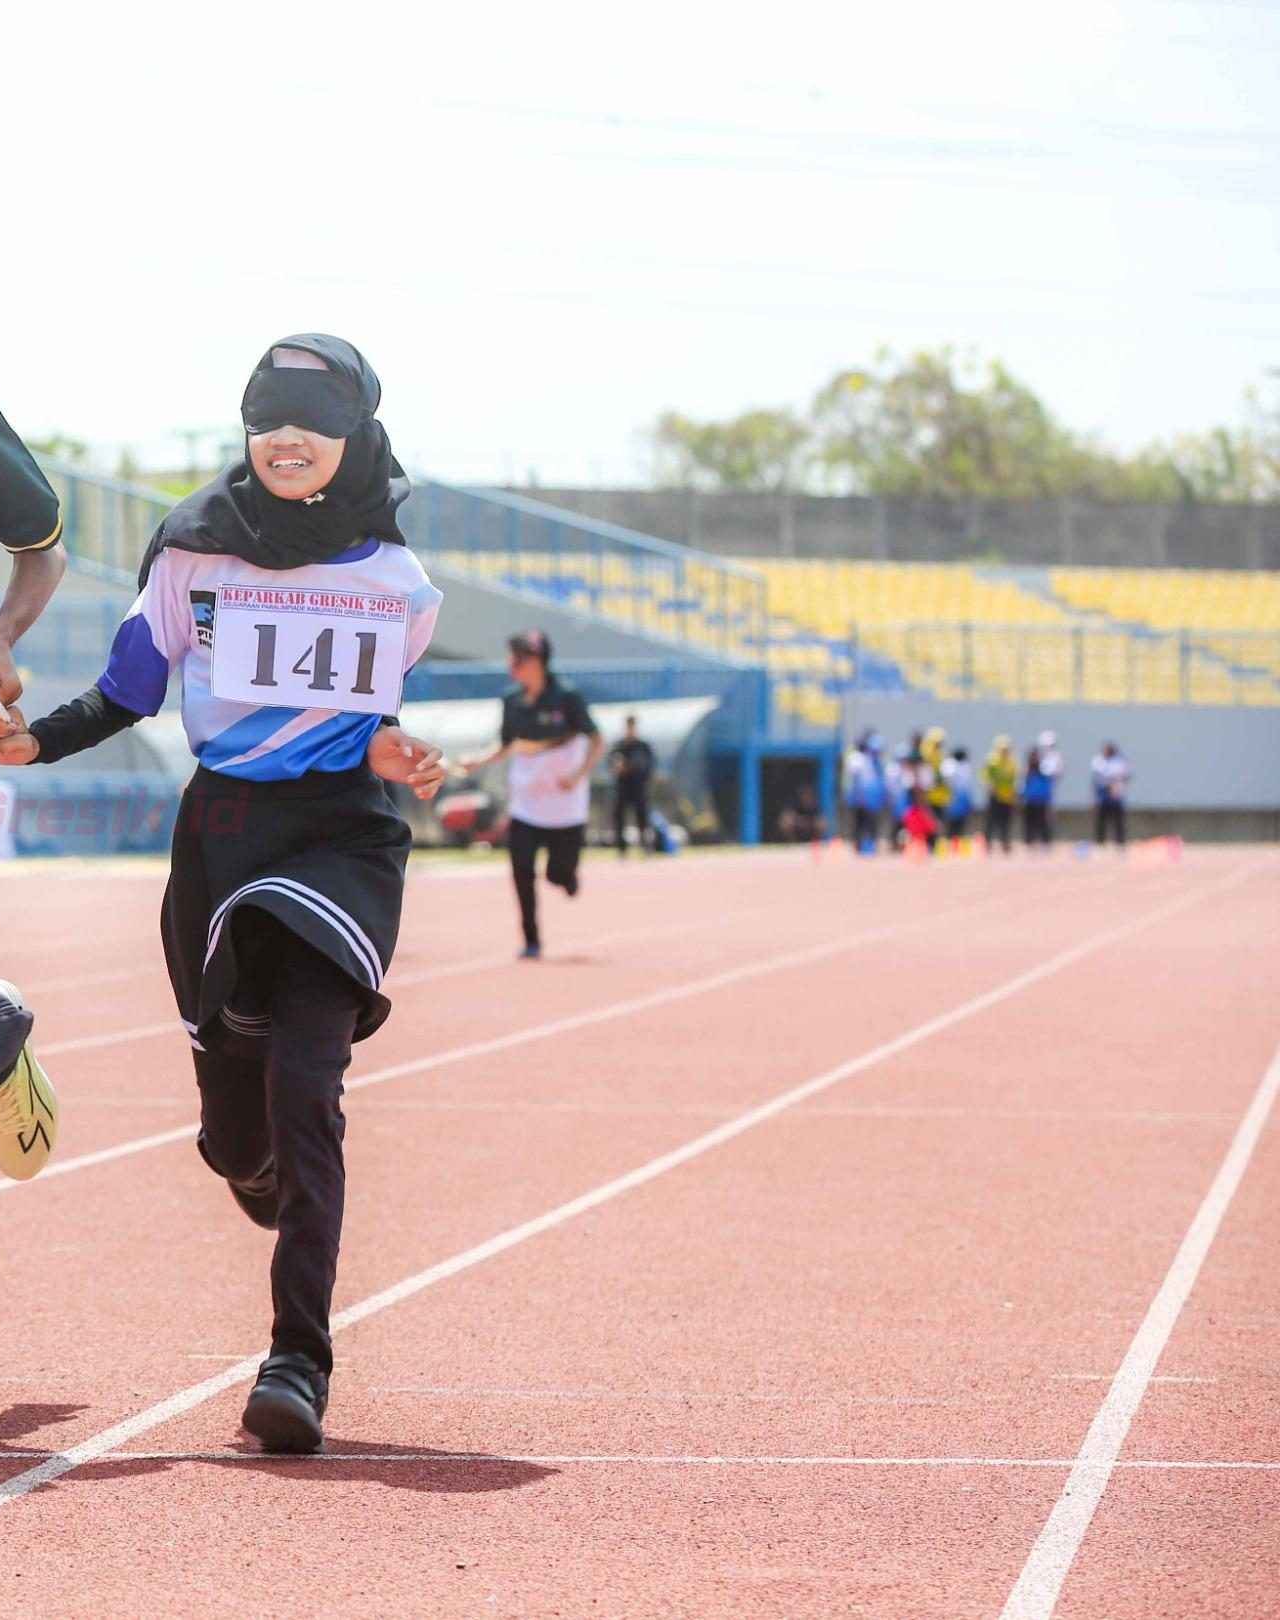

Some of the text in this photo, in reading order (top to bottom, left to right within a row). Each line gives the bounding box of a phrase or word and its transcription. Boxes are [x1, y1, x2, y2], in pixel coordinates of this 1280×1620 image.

[223, 589, 403, 614] KEPARKAB GRESIK 2025
[250, 624, 377, 695] 141
